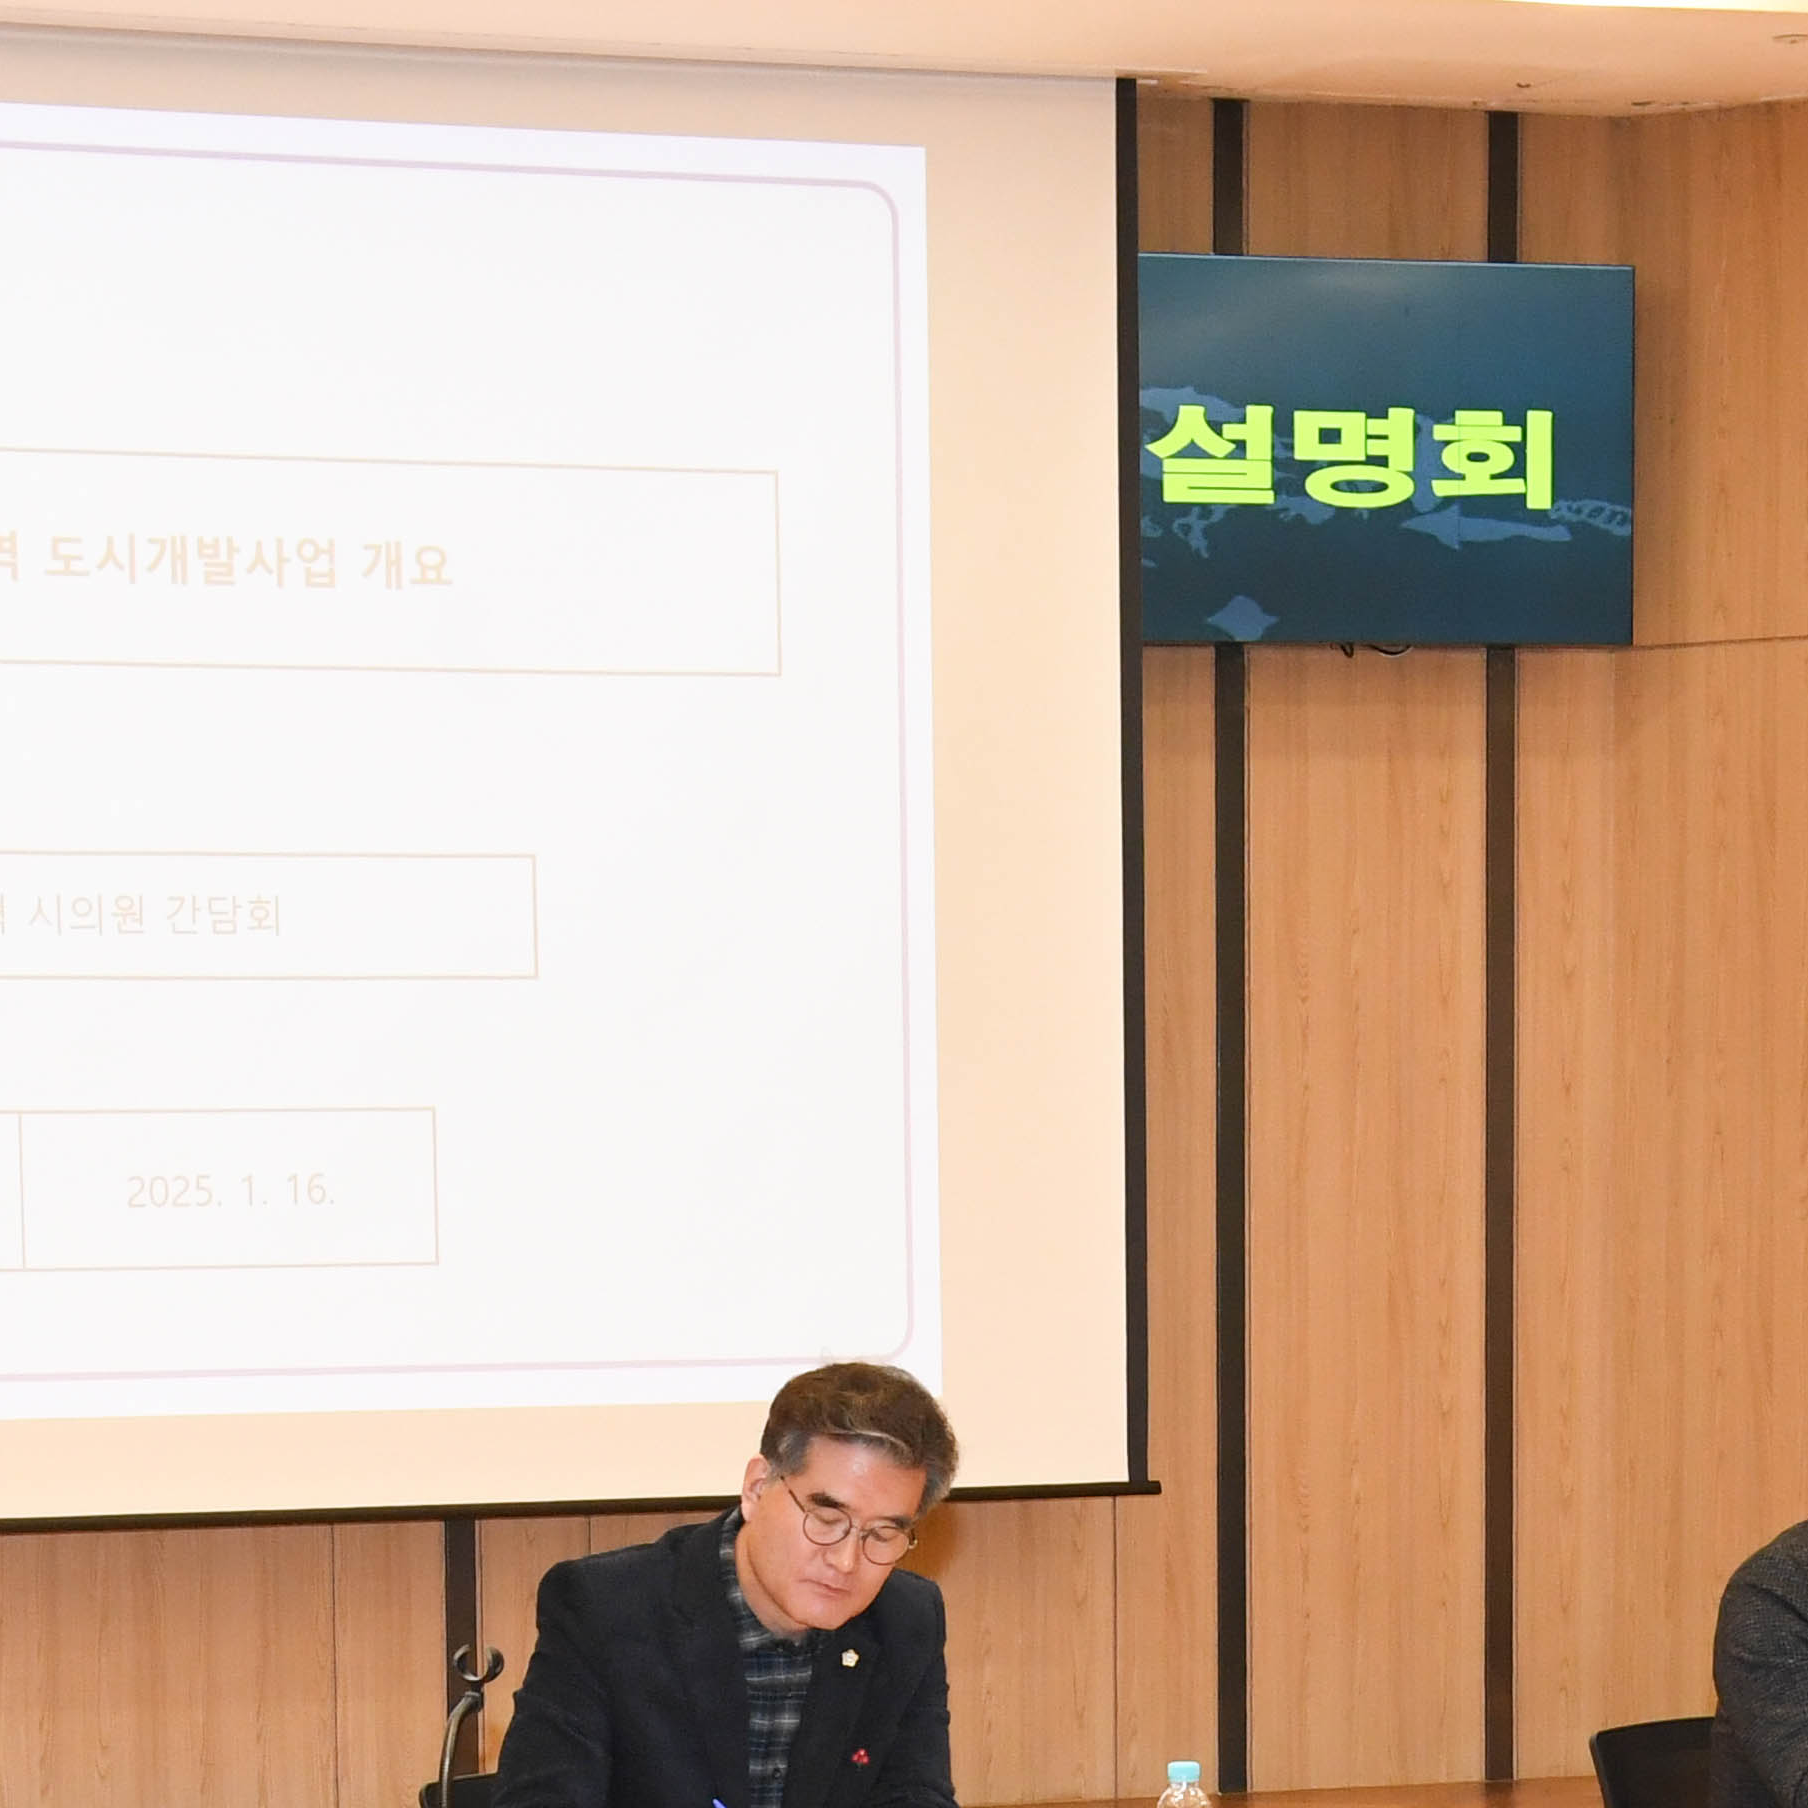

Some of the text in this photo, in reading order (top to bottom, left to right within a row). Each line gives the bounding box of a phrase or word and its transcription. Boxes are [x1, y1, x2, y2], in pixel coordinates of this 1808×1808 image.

[1144, 404, 1554, 510] 설명회
[45, 532, 337, 589] 도시개발사업
[361, 540, 454, 590] 개요
[28, 894, 146, 937] 시의원
[165, 895, 282, 938] 간담회
[126, 1173, 336, 1209] 2025. 1. 16.
